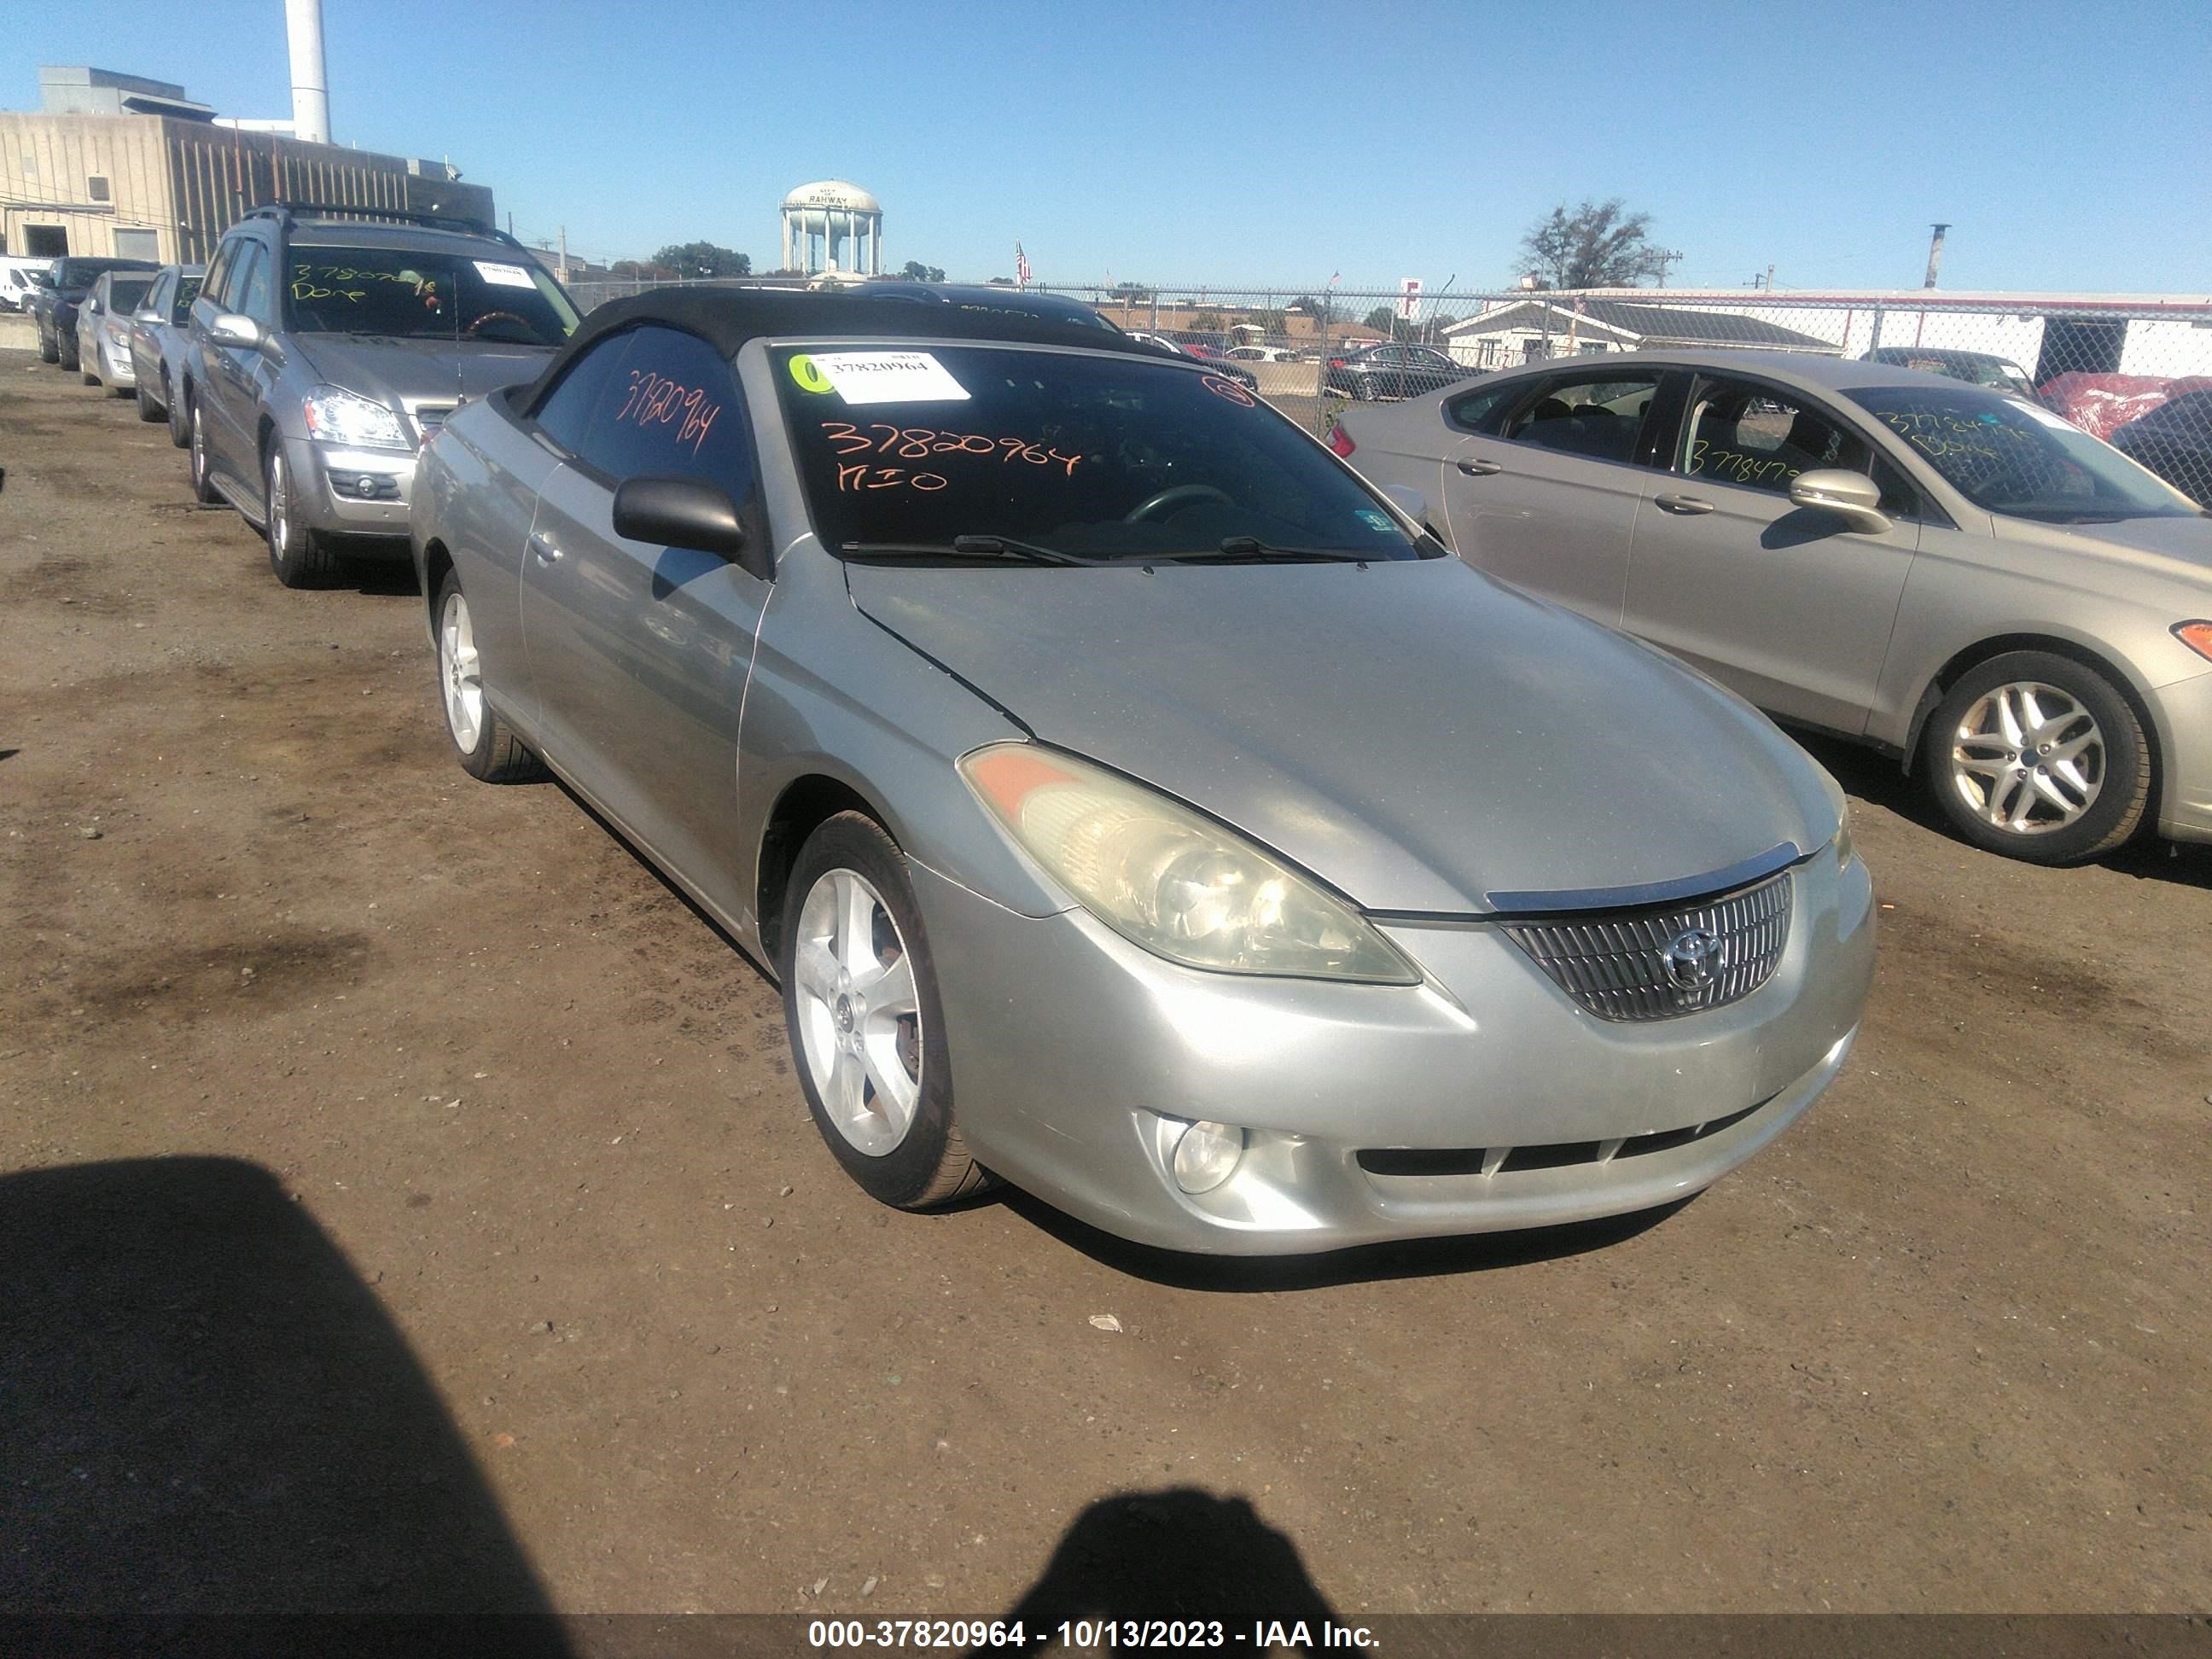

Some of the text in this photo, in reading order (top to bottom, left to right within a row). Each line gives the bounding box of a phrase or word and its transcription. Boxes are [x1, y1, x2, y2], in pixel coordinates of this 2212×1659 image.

[809, 195, 847, 205] RAHWAY
[832, 362, 928, 374] 37820964
[615, 370, 720, 456] 37820964
[821, 422, 1082, 477] 37820964
